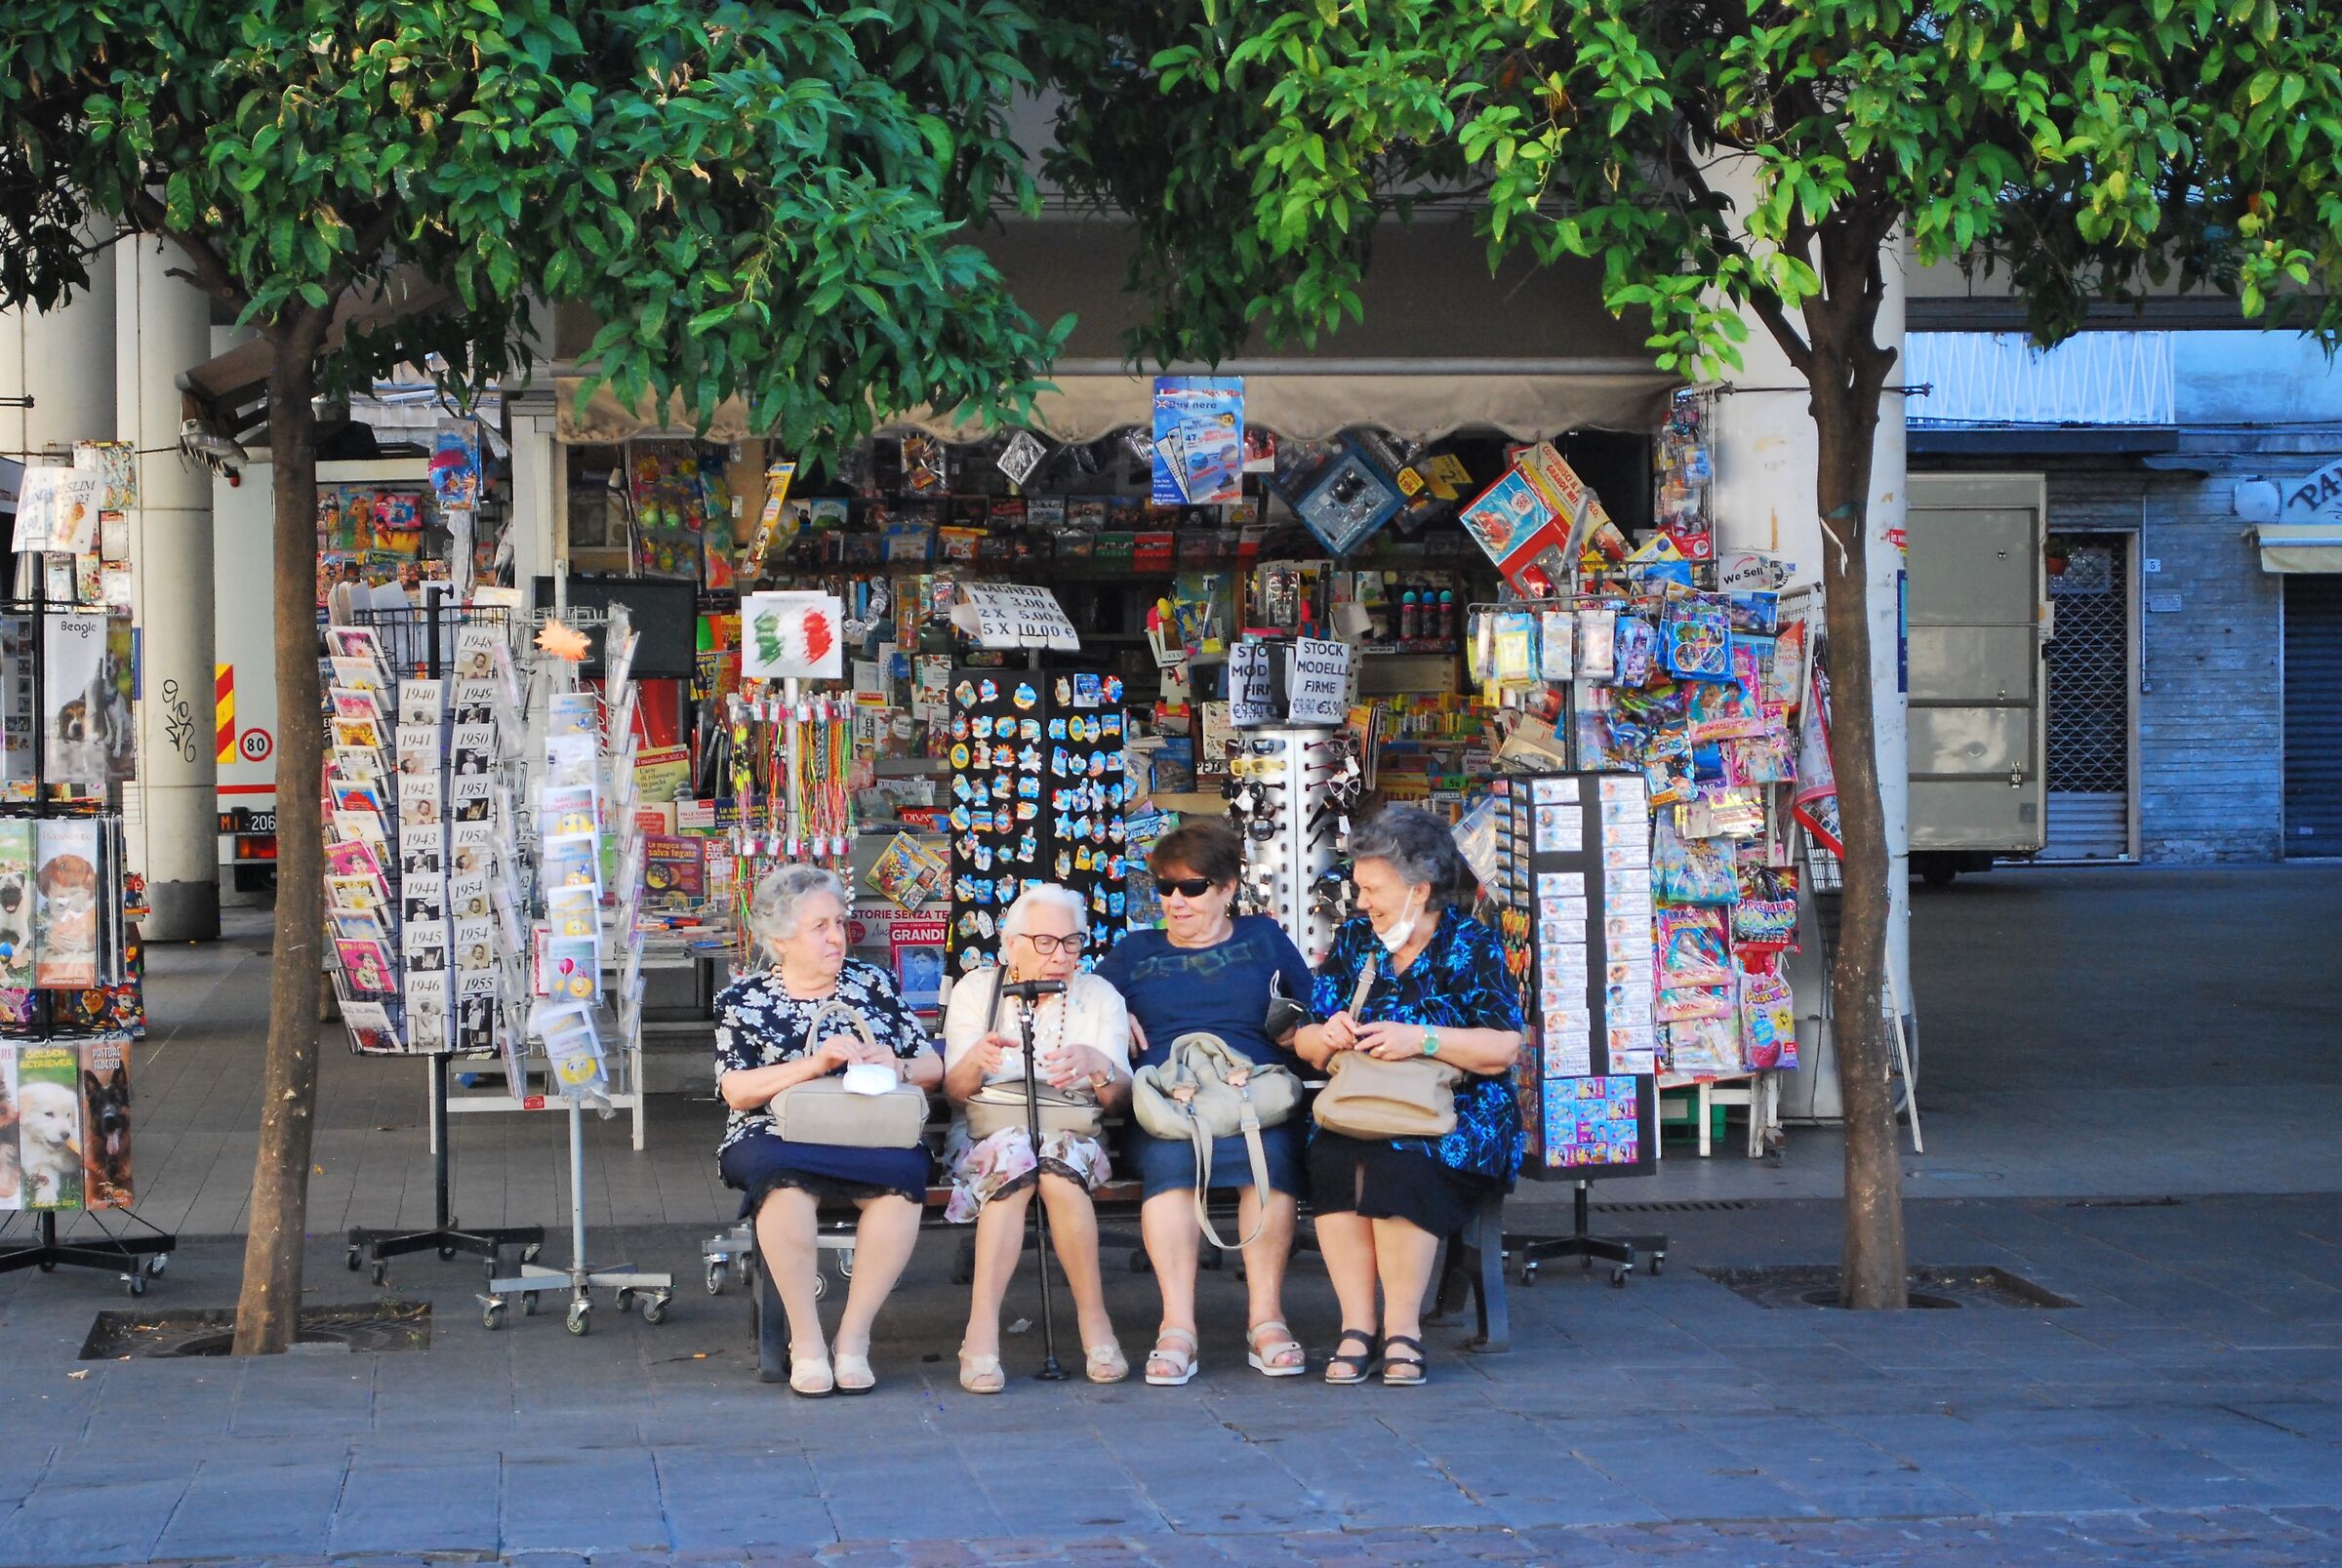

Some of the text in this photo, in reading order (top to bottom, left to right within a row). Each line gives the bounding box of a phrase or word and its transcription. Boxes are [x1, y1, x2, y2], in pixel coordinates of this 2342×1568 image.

[67, 480, 96, 492] SLIM
[2150, 561, 2156, 570] 5
[1723, 567, 1763, 584] We Sell
[972, 584, 1044, 597] MAGNETI
[973, 594, 980, 604] 1
[985, 594, 997, 605] X
[1010, 596, 1045, 609] 3.00
[979, 609, 990, 618] 2
[992, 609, 1007, 619] X
[1019, 611, 1054, 622] 5.00
[61, 621, 97, 638] Beagle
[983, 623, 1075, 638] 5 X 10.00 €
[464, 635, 492, 648] 1948
[1304, 642, 1344, 657] STOCK
[1297, 661, 1349, 676] MODELLI
[1304, 680, 1337, 694] FIRME
[405, 687, 435, 701] 1940
[464, 687, 493, 701] 1949
[247, 738, 265, 752] 80
[402, 733, 430, 746] 1941
[460, 733, 489, 745] 1950
[404, 783, 434, 795] 1942
[460, 783, 488, 795] 1951
[251, 816, 276, 830] 206
[406, 832, 436, 846] 1943
[408, 881, 438, 894] 1944
[456, 880, 483, 898] 1954
[851, 909, 892, 919] STORIE
[894, 909, 932, 919] SENZA
[412, 930, 442, 944] 1945
[460, 927, 488, 942] 1954
[891, 929, 946, 941] GRANDI
[410, 979, 440, 992] 1946
[464, 977, 494, 991] 1955
[25, 1049, 67, 1060] GOLDEN
[92, 1047, 122, 1059] PASTORE
[20, 1060, 73, 1070] RETRIEVER
[94, 1059, 120, 1071] TEDESCO
